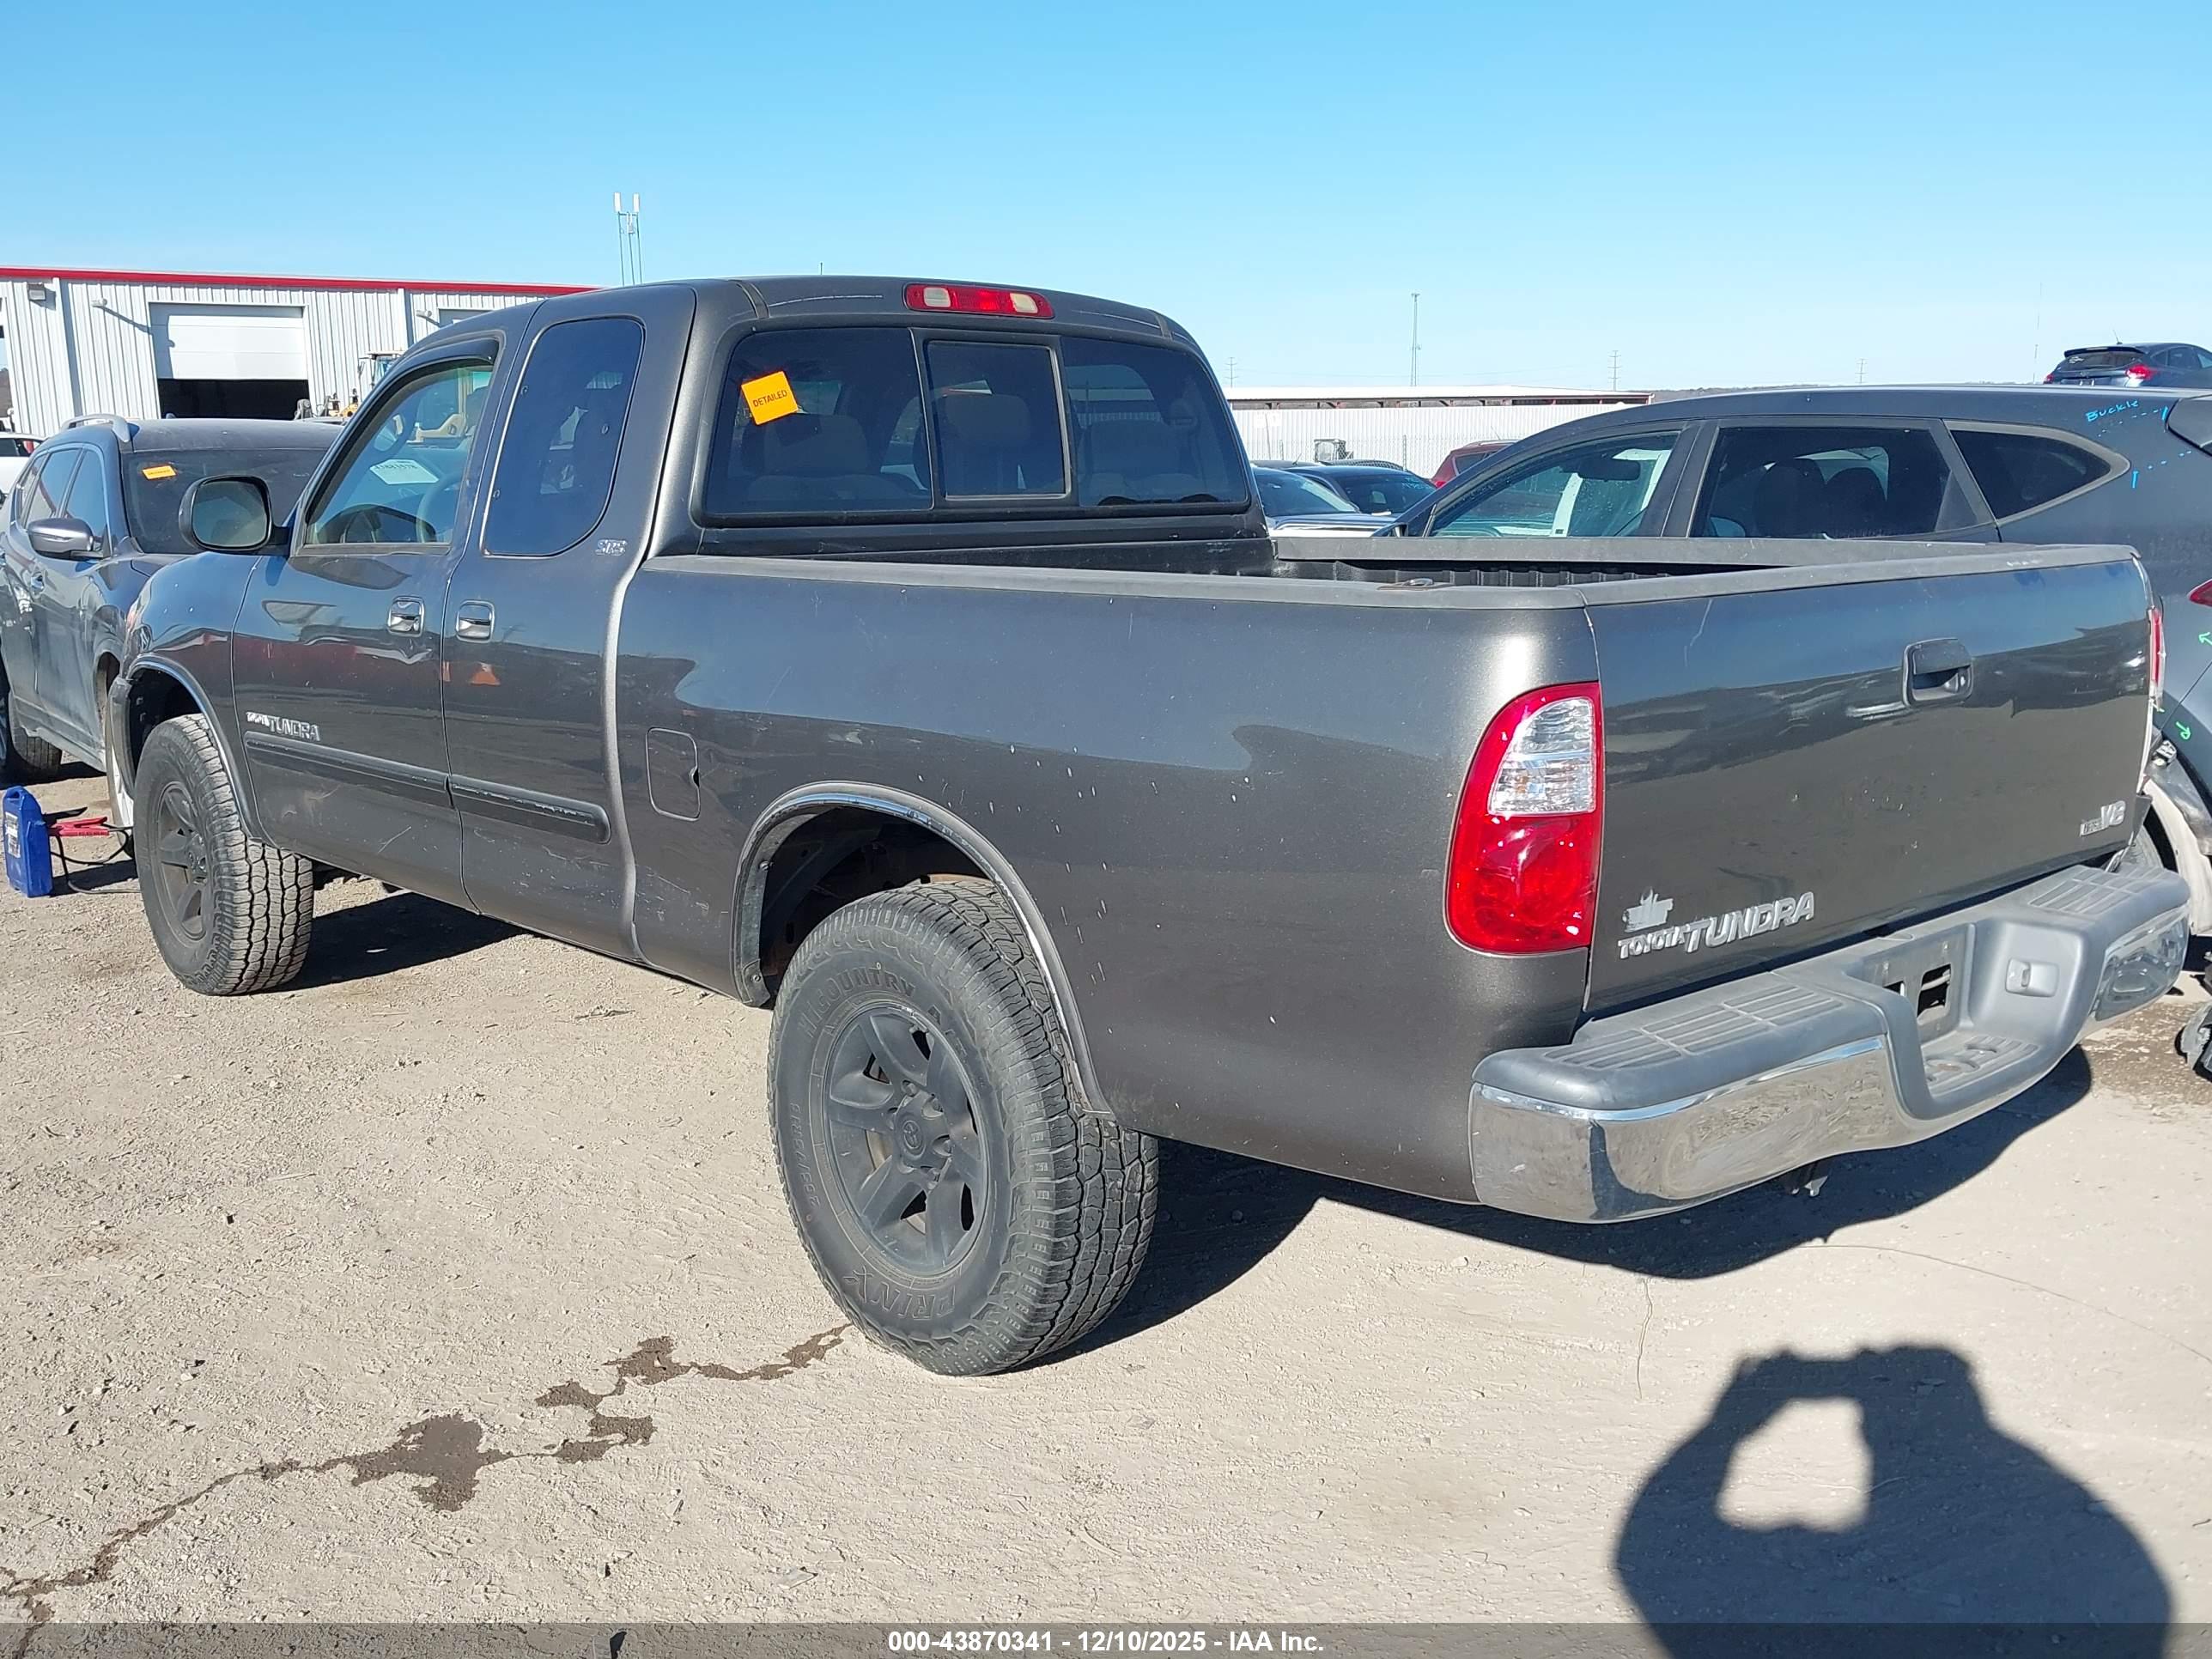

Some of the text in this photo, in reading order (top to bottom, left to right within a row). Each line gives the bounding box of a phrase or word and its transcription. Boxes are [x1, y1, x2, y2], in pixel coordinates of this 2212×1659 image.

[752, 390, 787, 407] DETAILED
[2086, 399, 2139, 422] Buckle
[268, 715, 320, 742] TUNDRA
[2100, 800, 2126, 828] V8
[1618, 891, 1815, 960] TOYOTA TUNDRA
